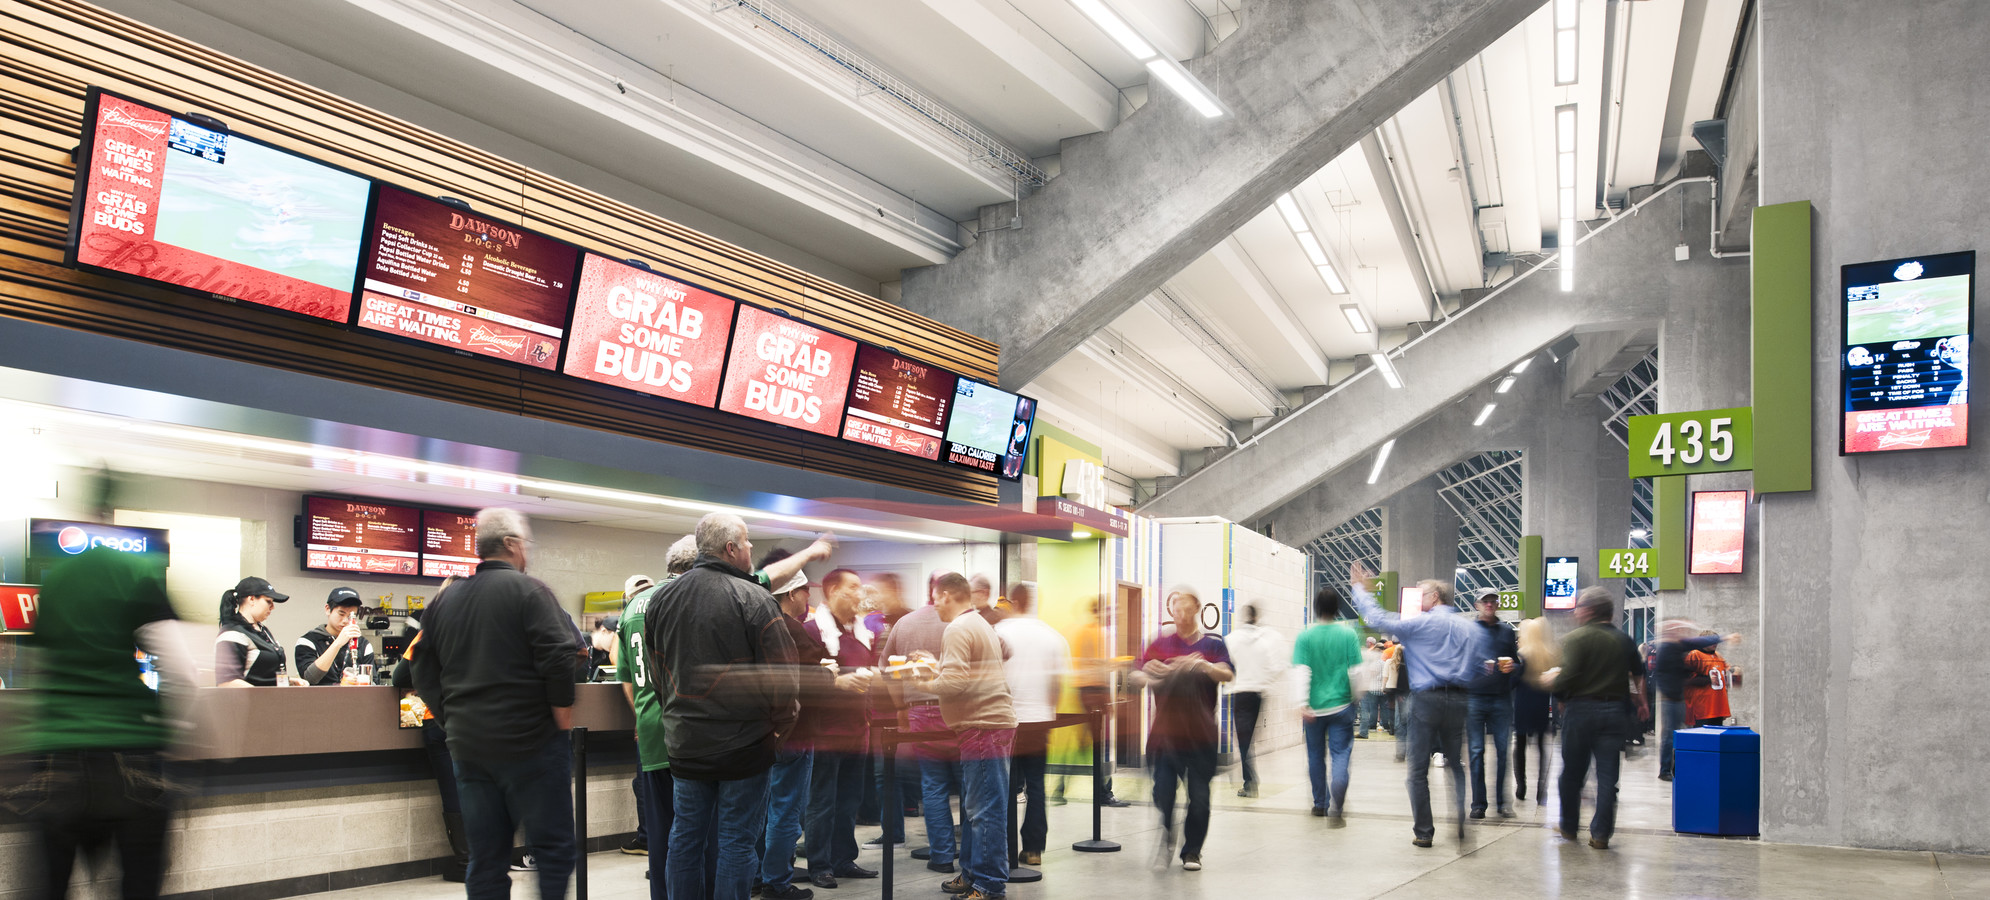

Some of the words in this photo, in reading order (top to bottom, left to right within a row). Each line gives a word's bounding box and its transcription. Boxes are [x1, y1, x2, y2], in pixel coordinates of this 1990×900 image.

[102, 108, 166, 134] Budweiser
[105, 138, 156, 162] GREAT
[104, 149, 154, 173] TIMES
[120, 166, 135, 174] ARE
[101, 166, 154, 188] WAITING.
[97, 191, 148, 215] GRAB
[110, 188, 124, 198] WHY
[124, 191, 138, 200] NOT
[104, 205, 138, 221] SOME
[94, 211, 145, 236] BUDS
[382, 222, 415, 238] Beverages
[449, 212, 523, 250] DAWSON
[380, 237, 396, 246] Pepsi
[396, 242, 422, 254] Collector
[422, 250, 432, 258] Cup
[382, 230, 398, 240] Pepsi
[398, 234, 410, 242] Soft
[410, 238, 428, 248] Drinks
[379, 244, 395, 254] Pepsi
[396, 248, 416, 260] Bottled
[416, 254, 432, 264] Water
[432, 260, 450, 270] Drinks
[462, 254, 474, 262] 4.50
[484, 254, 510, 266] Alcoholic
[510, 261, 538, 274] Beverages
[376, 264, 388, 272] Dole
[390, 266, 410, 278] Bottled
[410, 273, 426, 282] Juices
[400, 263, 420, 273] Bottled
[420, 268, 437, 278] Water
[482, 260, 505, 272] Domestic
[506, 266, 524, 278] Draught
[524, 272, 536, 280] Beer
[636, 277, 663, 296] WHY
[663, 286, 688, 304] NOT
[366, 297, 418, 322] GREAT
[416, 308, 462, 331] TIMES
[607, 285, 704, 340] GRAB
[362, 310, 396, 329] ARE
[398, 316, 462, 344] WAITING.
[779, 324, 802, 340] WHY
[801, 330, 820, 346] NOT
[470, 328, 524, 350] Budweiser
[618, 323, 684, 358] SOME
[532, 344, 548, 363] BC
[756, 332, 832, 378] GRAB
[1874, 353, 1885, 362] 14
[1930, 349, 1937, 357] 6
[594, 340, 694, 394] BUDS
[892, 358, 928, 380] DAWSON
[764, 364, 816, 394] SOME
[744, 379, 822, 426] BUDS
[1856, 410, 1903, 423] GREAT
[1904, 407, 1952, 420] TIMES
[848, 420, 870, 432] GREAT
[871, 424, 892, 438] TIMES
[1856, 422, 1887, 433] ARE
[1888, 418, 1956, 430] WAITING.
[845, 428, 862, 439] ARE
[862, 431, 892, 446] WAITING.
[1649, 417, 1734, 465] 435
[949, 452, 978, 468] MAXIMUM
[979, 460, 994, 472] TASTE
[950, 442, 968, 454] ZERO
[968, 446, 996, 462] CALORIES
[346, 503, 386, 516] DAWSON
[1062, 502, 1072, 514] SEATS
[91, 536, 147, 552] pepsi
[310, 559, 327, 567] ARE
[328, 561, 362, 569] WAITING.
[337, 554, 361, 562] TIMES
[1610, 552, 1650, 574] 434
